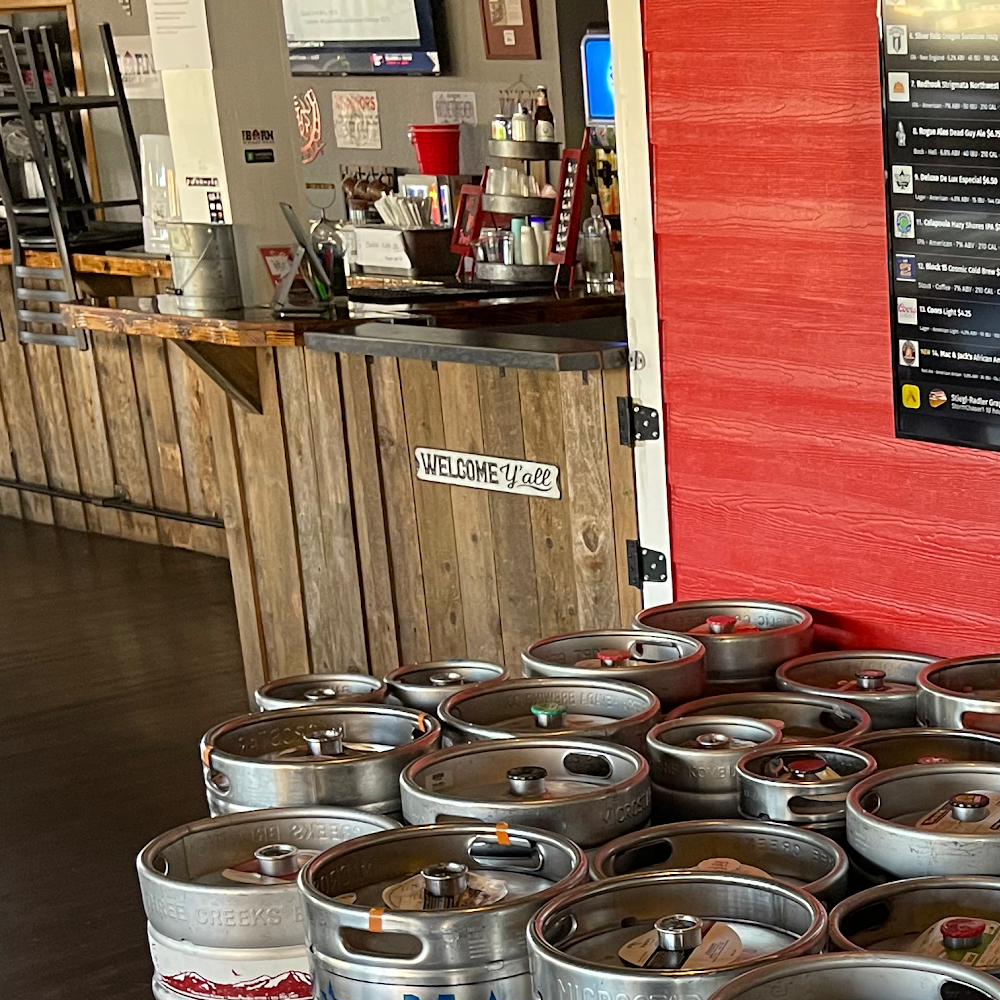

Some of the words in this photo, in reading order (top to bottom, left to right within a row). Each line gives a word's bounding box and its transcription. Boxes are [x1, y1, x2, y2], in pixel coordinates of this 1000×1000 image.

[925, 263, 941, 271] Block
[968, 266, 981, 274] Cold
[927, 306, 942, 314] Coors
[943, 308, 957, 317] Light
[951, 393, 988, 406] Stiegl-Radler
[420, 452, 500, 485] WELCOME
[500, 463, 553, 489] Y'all
[195, 907, 282, 927] CREEKS
